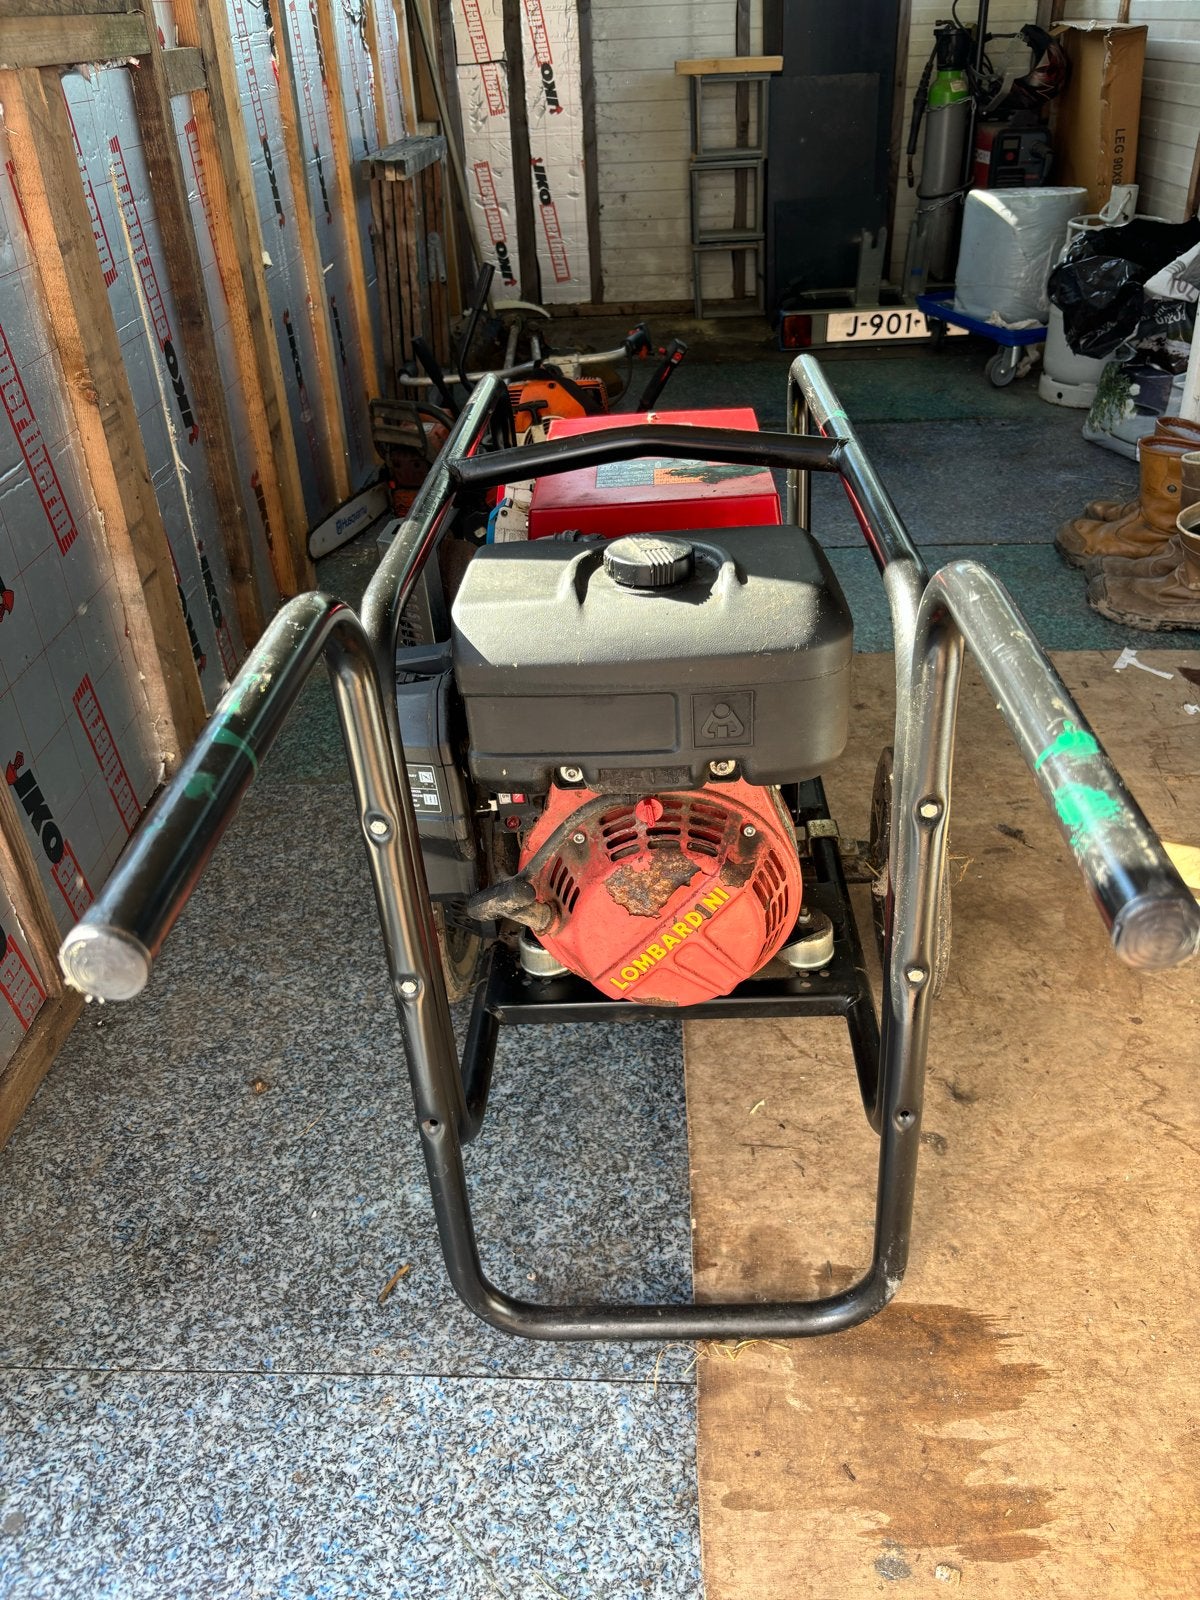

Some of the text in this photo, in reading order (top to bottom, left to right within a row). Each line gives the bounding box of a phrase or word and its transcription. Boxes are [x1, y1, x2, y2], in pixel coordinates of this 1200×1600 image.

[540, 63, 559, 107] IKO
[1114, 128, 1126, 155] LEG
[534, 165, 552, 205] IKO
[495, 241, 514, 279] IKO
[846, 313, 932, 337] J-901-
[164, 340, 195, 429] IKO
[201, 555, 223, 630] IKO
[13, 768, 64, 864] IKO
[609, 886, 730, 991] LOMBARDINI
